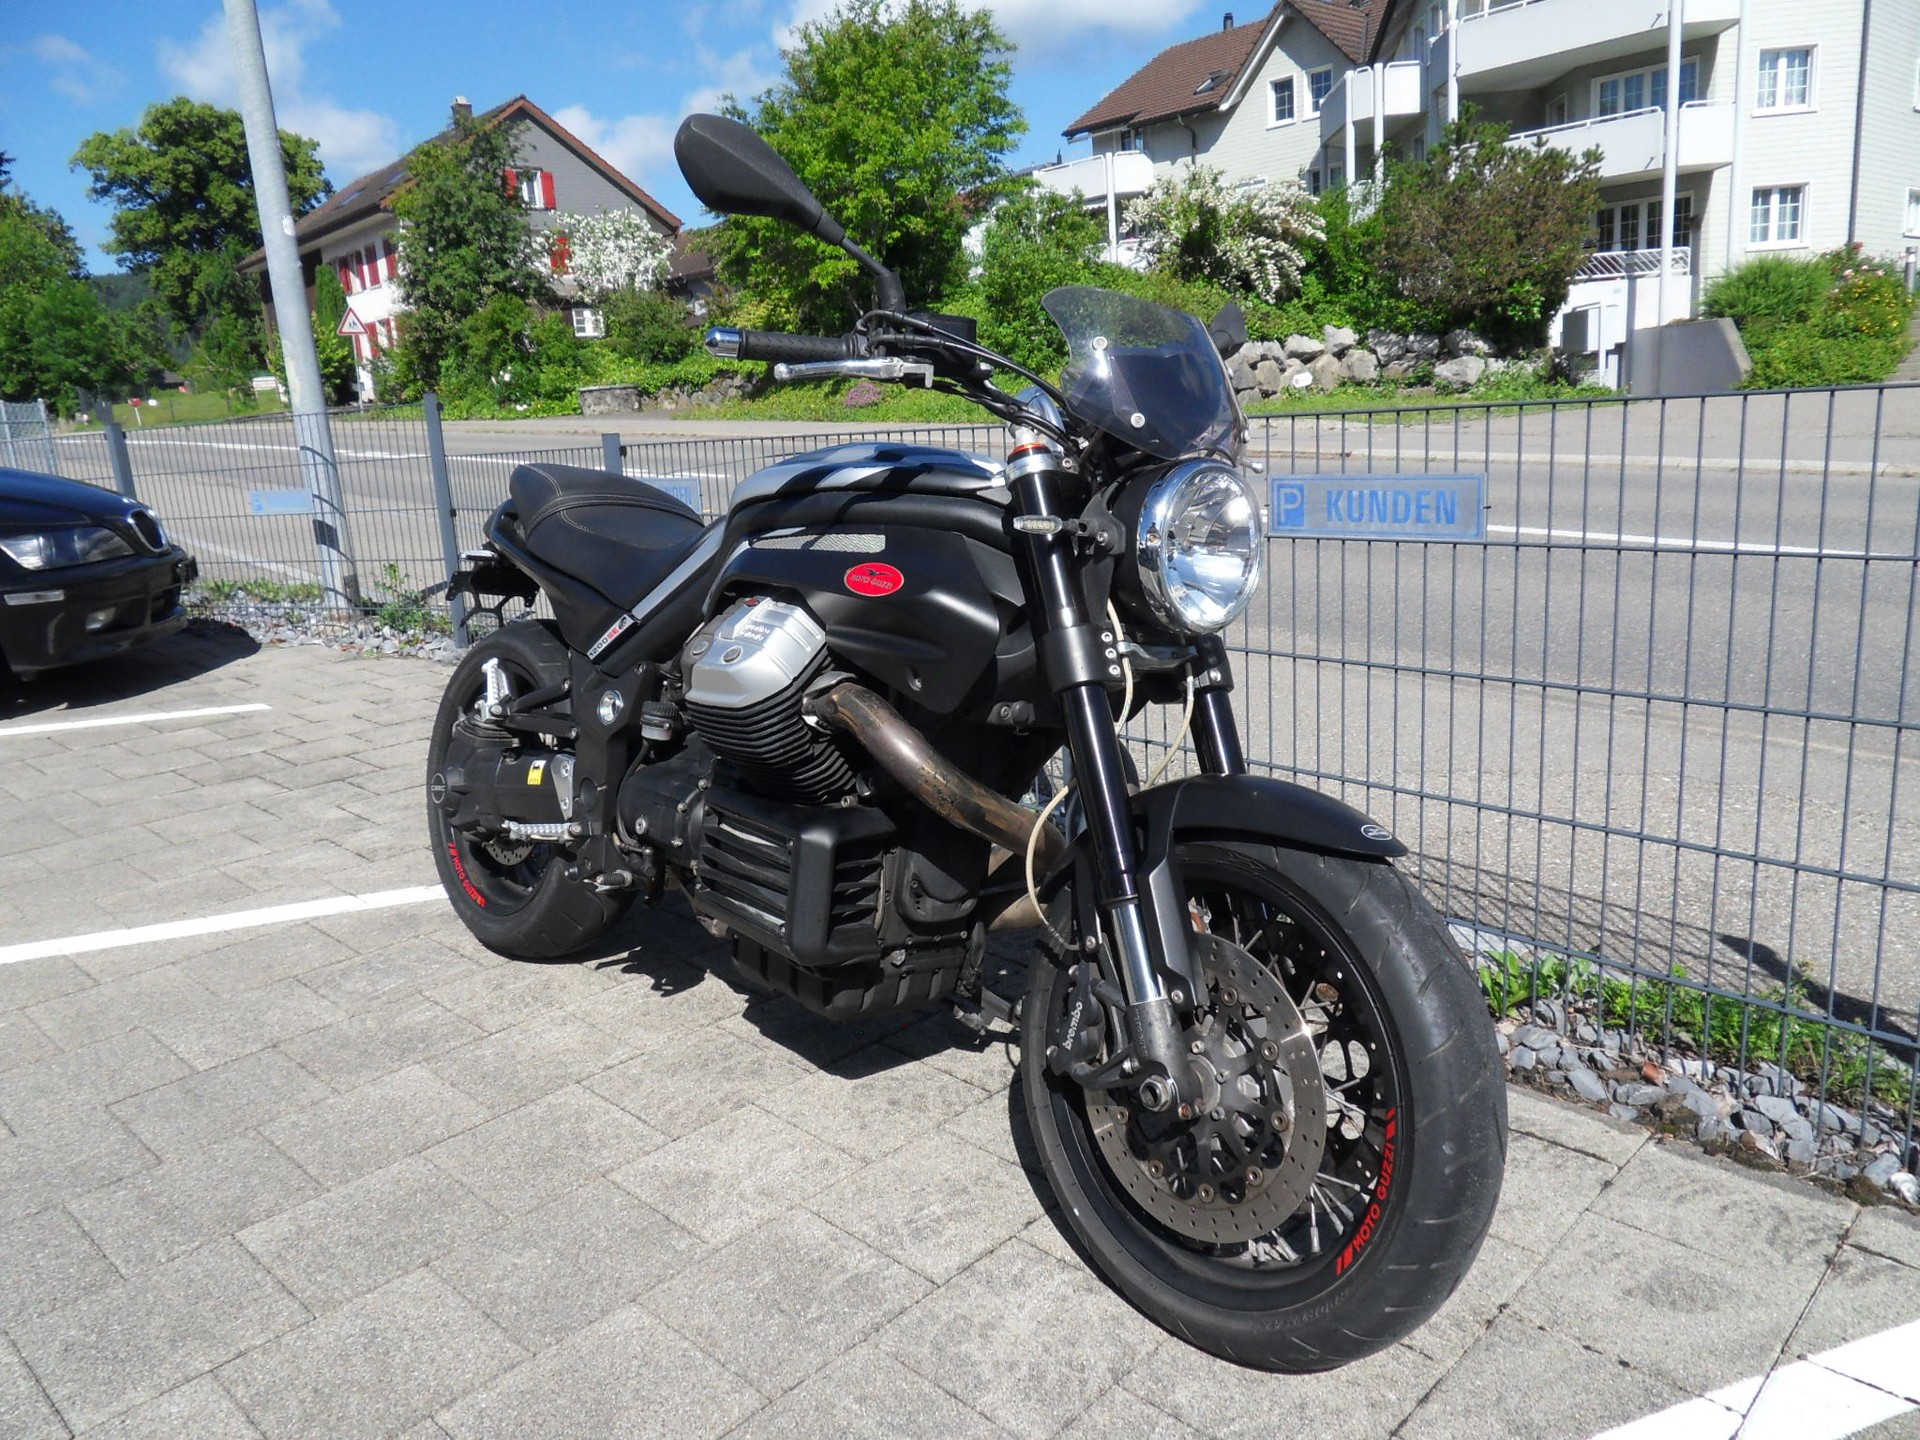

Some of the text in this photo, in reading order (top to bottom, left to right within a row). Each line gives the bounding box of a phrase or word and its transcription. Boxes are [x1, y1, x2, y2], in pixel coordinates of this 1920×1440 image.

[1279, 487, 1458, 525] P KUNDEN
[850, 573, 894, 590] MOTO GUZZI
[452, 856, 467, 880] MOTO
[1062, 1001, 1083, 1051] brembo
[1351, 1143, 1395, 1252] MOTO GUZZI
